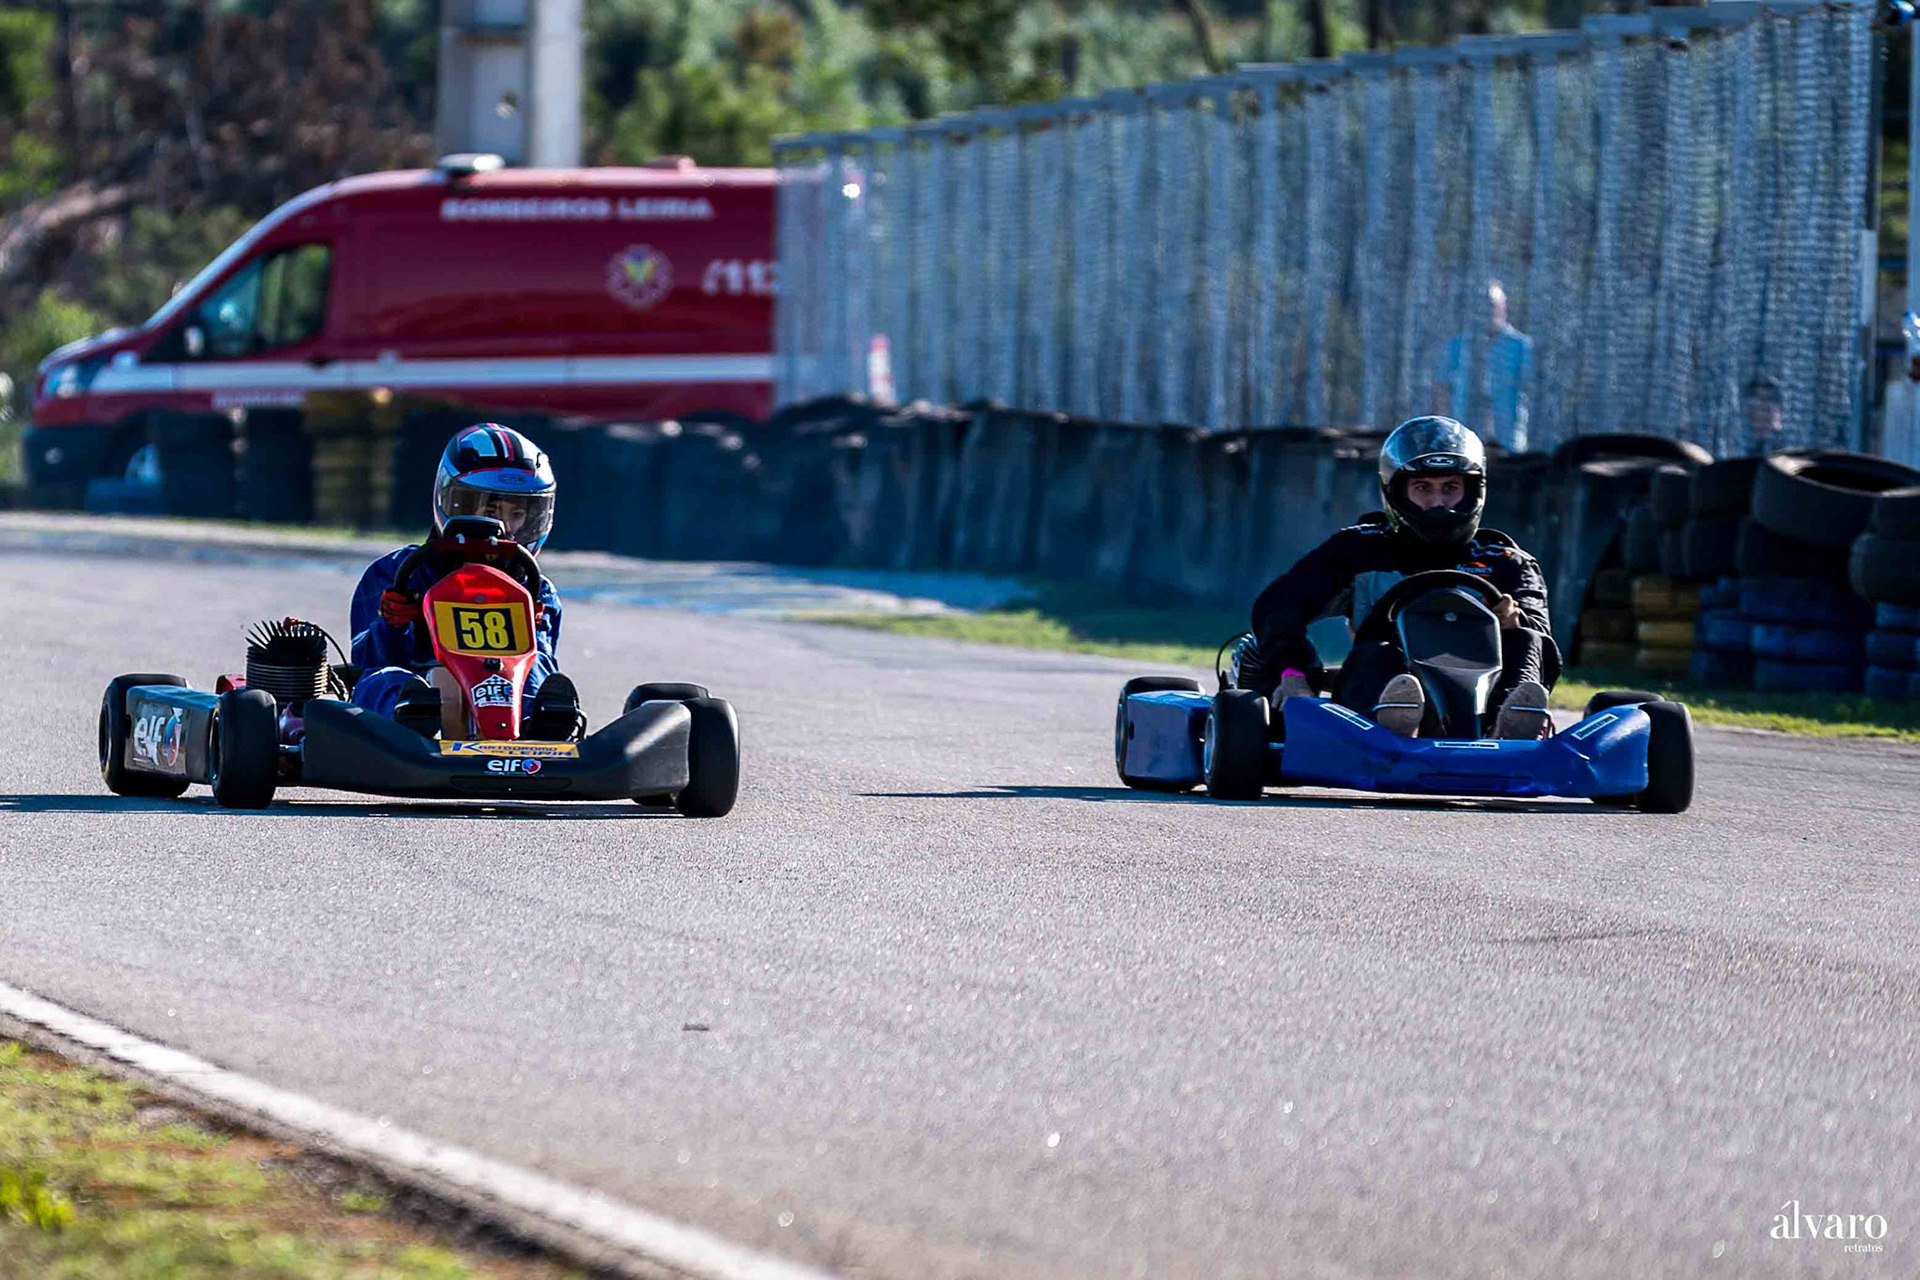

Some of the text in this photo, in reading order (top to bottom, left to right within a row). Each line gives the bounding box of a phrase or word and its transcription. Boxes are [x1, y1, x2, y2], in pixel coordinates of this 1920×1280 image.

[440, 198, 715, 220] BOMBEIROS LEIRIA
[459, 611, 509, 648] 58
[475, 685, 502, 698] elf
[133, 715, 165, 766] elf
[487, 759, 521, 772] elf
